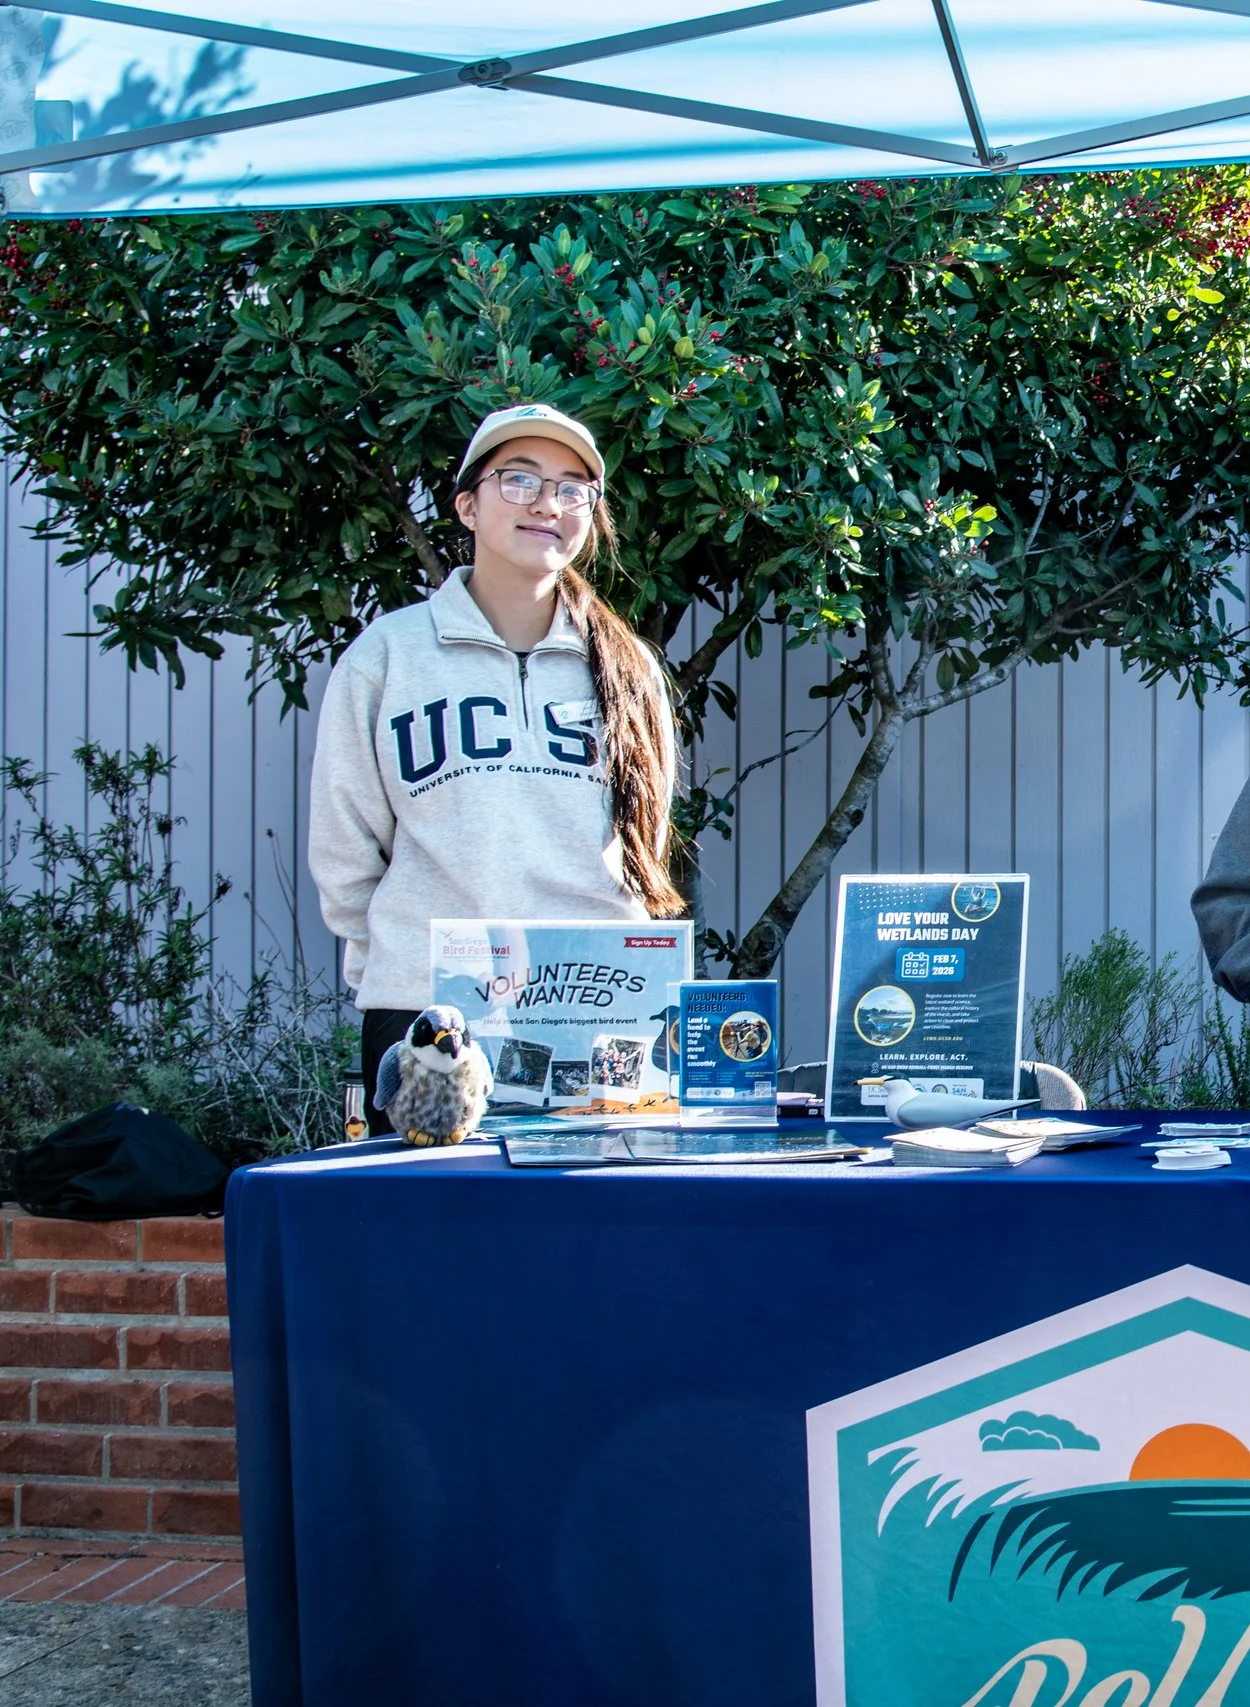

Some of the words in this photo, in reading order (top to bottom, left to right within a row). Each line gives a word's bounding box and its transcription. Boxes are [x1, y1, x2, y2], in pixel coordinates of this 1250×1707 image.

[409, 766, 480, 798] UNIVERSITY
[509, 765, 581, 779] CALIFORNIA
[877, 912, 912, 925] LOVE
[913, 912, 949, 925] YOUR
[877, 928, 949, 941] WETLANDS
[951, 928, 980, 940] DAY
[653, 939, 671, 947] Today
[443, 946, 465, 954] Bird
[467, 945, 511, 955] Festival
[933, 955, 949, 963] FEB
[951, 955, 959, 965] 7,
[932, 967, 954, 975] 2026
[475, 962, 646, 1002] VOLUNTEERS
[514, 984, 614, 1010] WANTED
[688, 993, 747, 1002] VOLUNTEERS
[525, 1017, 540, 1025] San
[541, 1017, 567, 1026] Diego's
[569, 1017, 597, 1026] biggest
[599, 1017, 614, 1025] bird
[687, 1060, 716, 1068] smoothly
